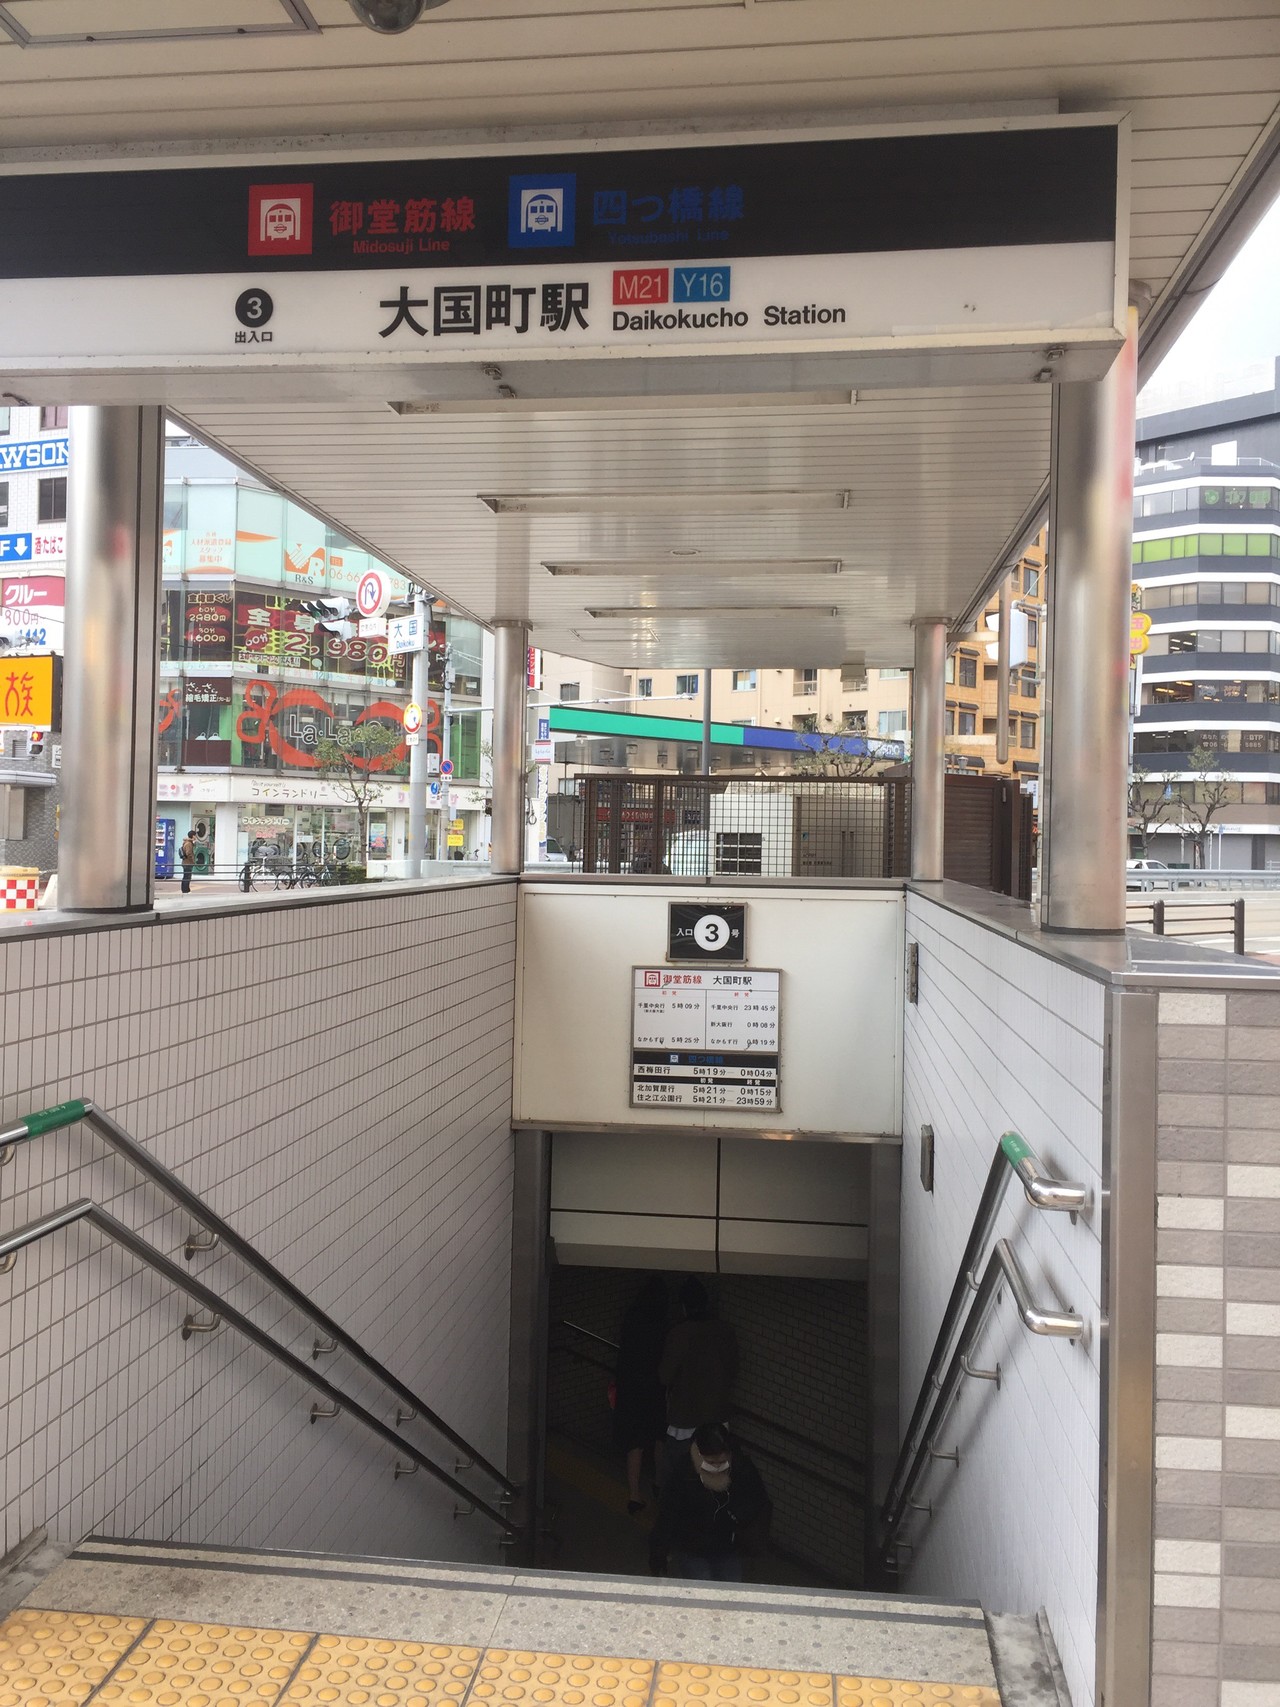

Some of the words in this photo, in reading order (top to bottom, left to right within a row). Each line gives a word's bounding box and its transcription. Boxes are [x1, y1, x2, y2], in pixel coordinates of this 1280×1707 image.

[593, 185, 745, 226] 四つ橋線
[329, 196, 475, 236] 御堂筋線
[697, 229, 729, 242] Line
[353, 239, 413, 254] Midosuji
[419, 238, 450, 252] Line
[620, 275, 662, 299] M21
[681, 273, 724, 297] Y16
[247, 297, 262, 319] 3
[379, 283, 589, 337] 大国町駅
[613, 307, 749, 331] Daikokucho
[763, 304, 846, 326] Station
[234, 331, 273, 343] 出入口
[295, 574, 313, 584] R&S
[394, 619, 418, 639] 大国
[251, 787, 328, 800] コインランドリー
[676, 927, 693, 937] 入口
[705, 923, 719, 943] 3
[731, 928, 740, 938] 号
[663, 975, 702, 985] 御堂筋線
[713, 976, 753, 986] 大国町駅
[638, 1066, 671, 1074] 西梅田行
[637, 1094, 683, 1102] 住之江公園行
